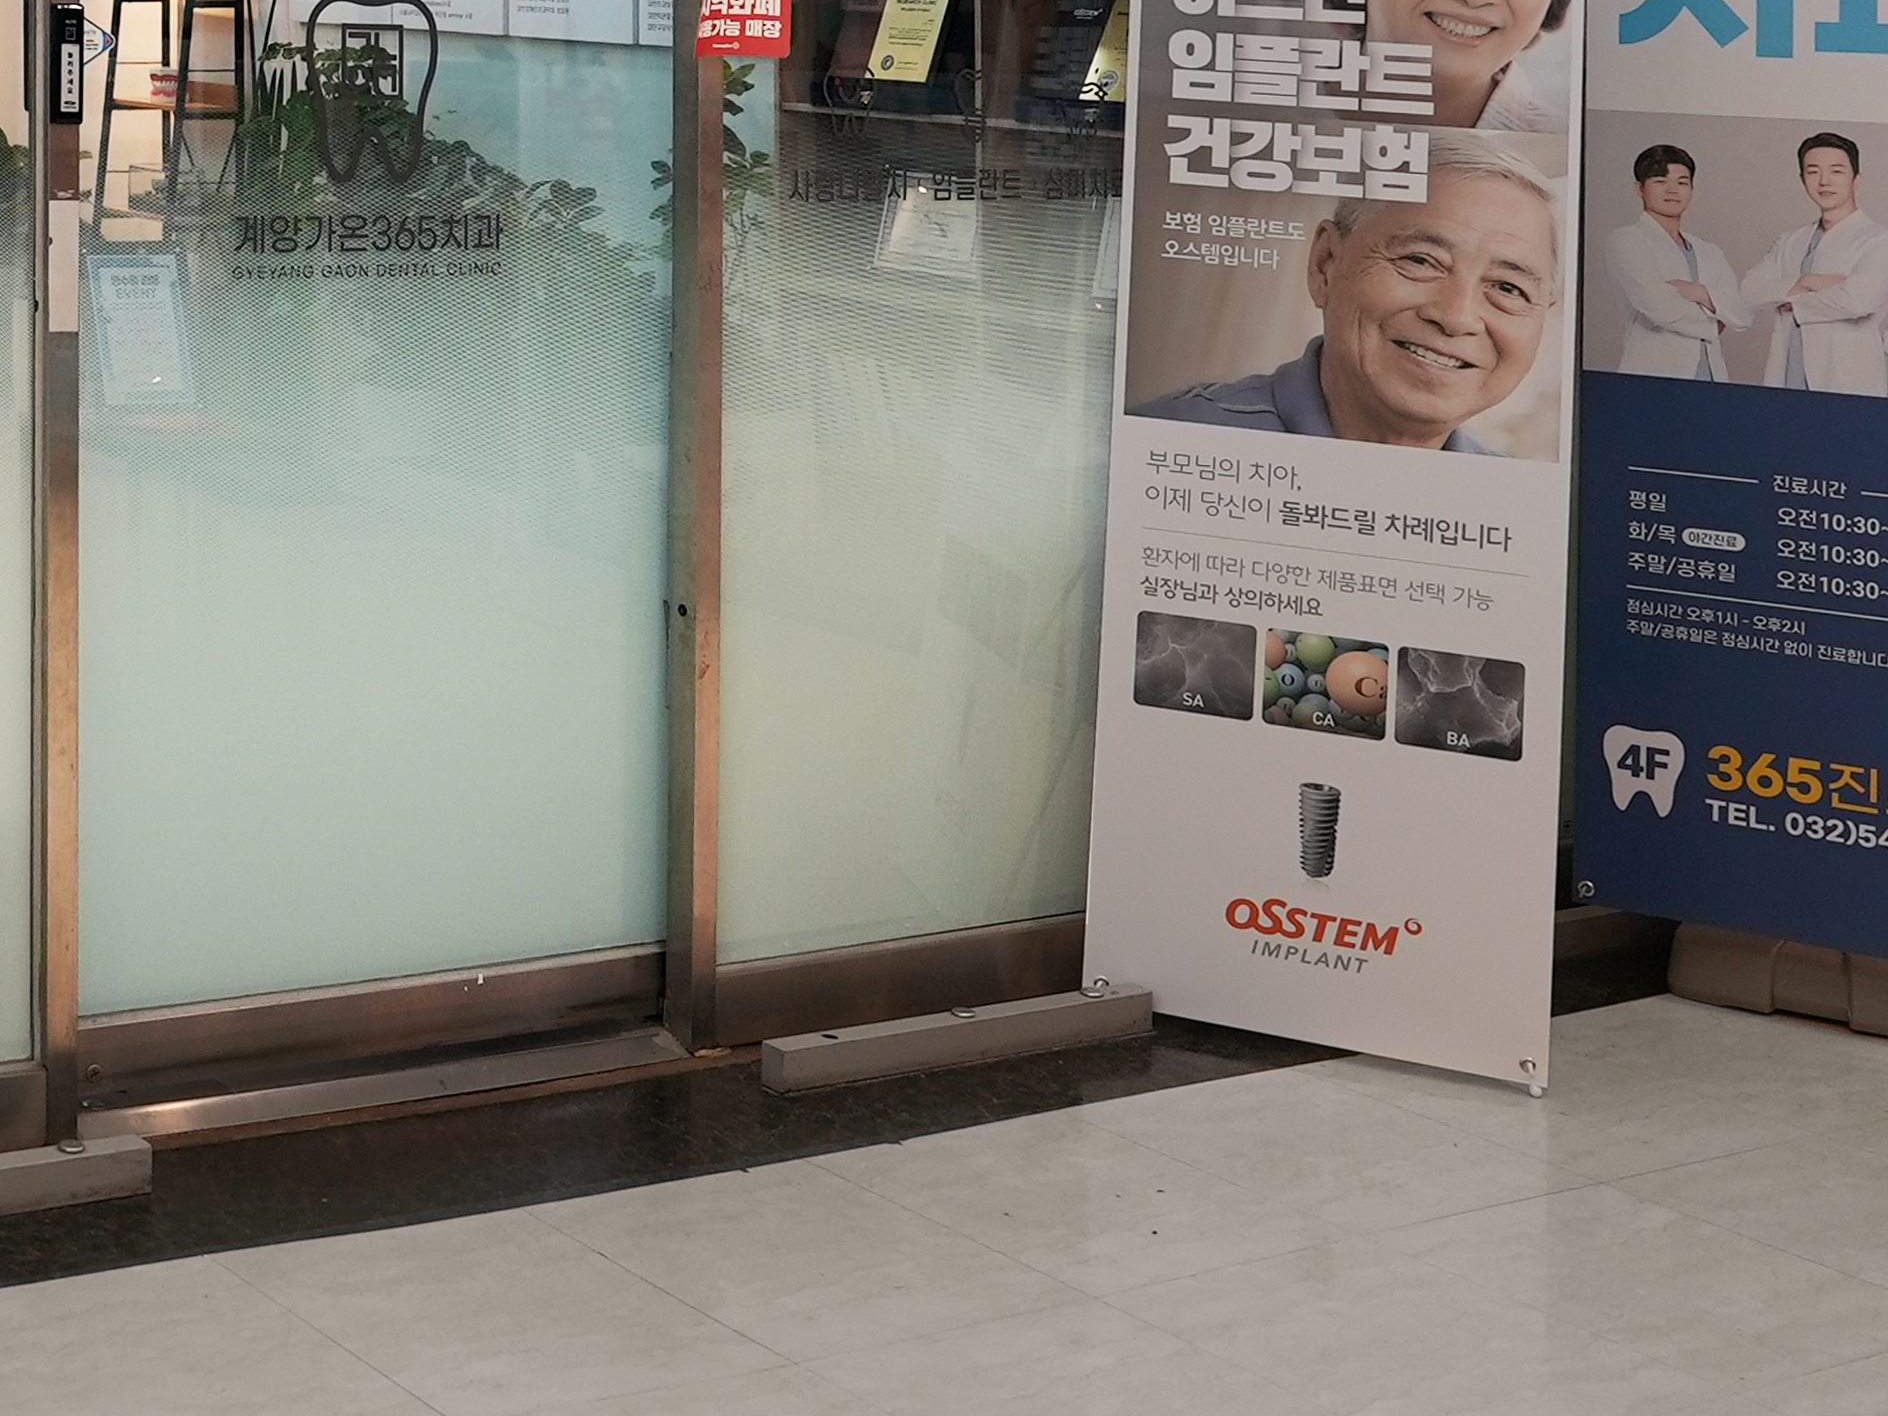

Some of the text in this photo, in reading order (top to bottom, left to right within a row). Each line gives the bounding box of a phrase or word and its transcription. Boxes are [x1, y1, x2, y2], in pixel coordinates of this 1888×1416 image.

[699, 18, 782, 39] 용가능 매장
[1167, 29, 1435, 116] 임플란트
[1163, 114, 1431, 204] 건강보험
[233, 212, 504, 255] 계양가온365치과
[1162, 210, 1307, 242] 보험 임플란트도
[232, 261, 503, 281] GYEYANG GAON DENTAL CLINIC
[1160, 240, 1280, 270] 오스템입니다
[1145, 449, 1302, 492] 부모님의 치아,
[1772, 474, 1847, 500] 진료시간
[1144, 484, 1513, 554] 이제 당신이 돌봐드릴 차례입니다
[1628, 490, 1667, 513] 평일
[1627, 522, 1676, 545] 화/목
[1684, 530, 1739, 548] 야간진료
[1141, 545, 1494, 612] 환자에 따라 다양한 제품표면 선택 가능
[1627, 551, 1736, 583] 주말/공휴일
[1139, 574, 1323, 618] 실장님과 상의하세요
[1626, 598, 1683, 620] 점심시간
[1686, 605, 1739, 628] 오후1시
[1752, 615, 1806, 636] 오후2시
[1625, 619, 1718, 645] 주말/공휴일은
[1722, 630, 1780, 654] 점심시간
[1784, 639, 1813, 659] 없이
[1182, 691, 1205, 709] SA
[1312, 710, 1336, 729] CA
[1446, 731, 1471, 749] BA
[1616, 743, 1671, 781] 4F
[1706, 745, 1888, 815] 365진
[1705, 798, 1776, 832] TEL.
[1225, 897, 1400, 956] OSSTEM
[1250, 938, 1370, 975] IMPLANT
